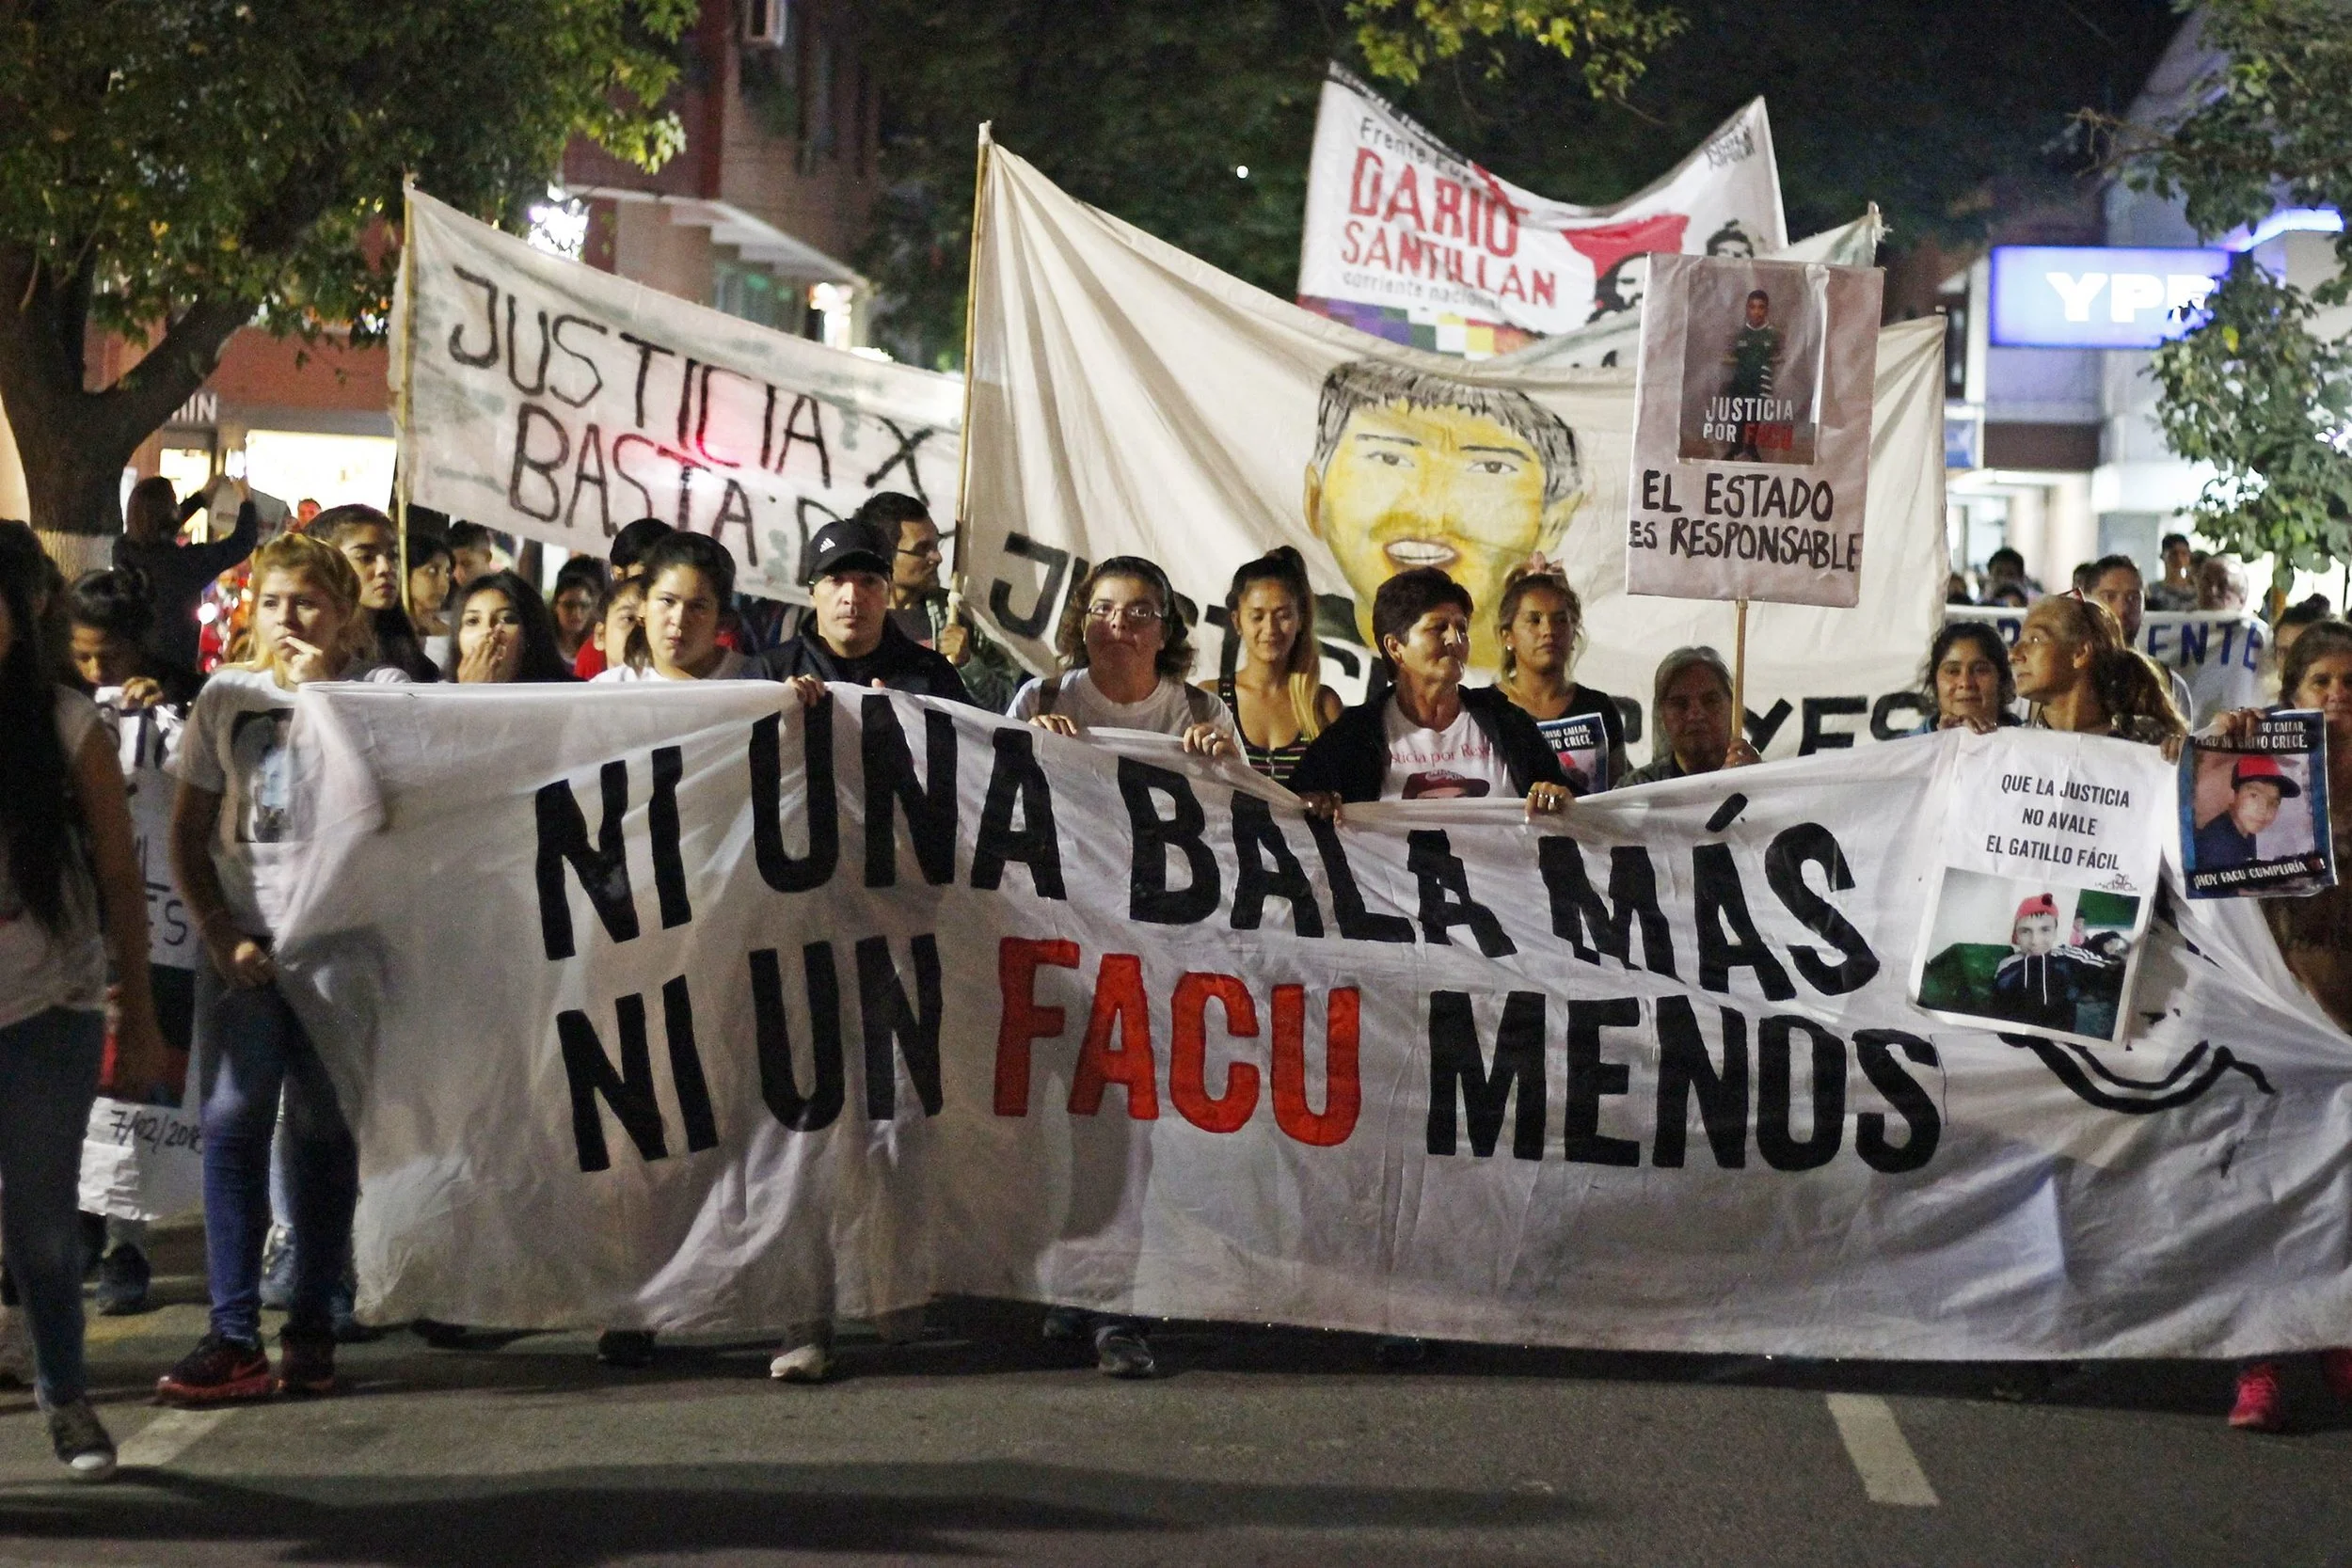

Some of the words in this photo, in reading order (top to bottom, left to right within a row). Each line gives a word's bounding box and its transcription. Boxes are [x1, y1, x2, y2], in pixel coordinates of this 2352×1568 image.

[1342, 220, 1557, 309] SANTILLAN
[448, 264, 833, 489] JUSTICIA
[865, 417, 934, 507] X
[1706, 396, 1793, 422] JUSTICIA
[1703, 423, 1737, 443] POR
[509, 403, 757, 567] BASTA
[1642, 469, 1683, 514] EL
[1705, 472, 1835, 522] ESTADO
[1629, 520, 1658, 549] ES
[1670, 516, 1864, 572] RESPONSABLE
[2001, 774, 2032, 794] QUE
[2036, 778, 2055, 797] LA
[2059, 781, 2130, 808] JUSTICIA
[533, 745, 692, 960] NI
[749, 692, 1067, 900] UNA
[1117, 755, 1517, 958] BALA
[1537, 793, 1880, 1001] MÁS
[2022, 808, 2044, 826] NO
[2048, 811, 2098, 836] AVALE
[1986, 835, 2003, 854] EL
[2009, 838, 2073, 864] GATILLO
[2076, 847, 2120, 870] FÁCIL
[2220, 870, 2246, 883] FACU
[556, 974, 721, 1172] NI
[748, 933, 945, 1132] UN
[993, 938, 1363, 1148] FACU
[1426, 990, 1944, 1174] MENOS
